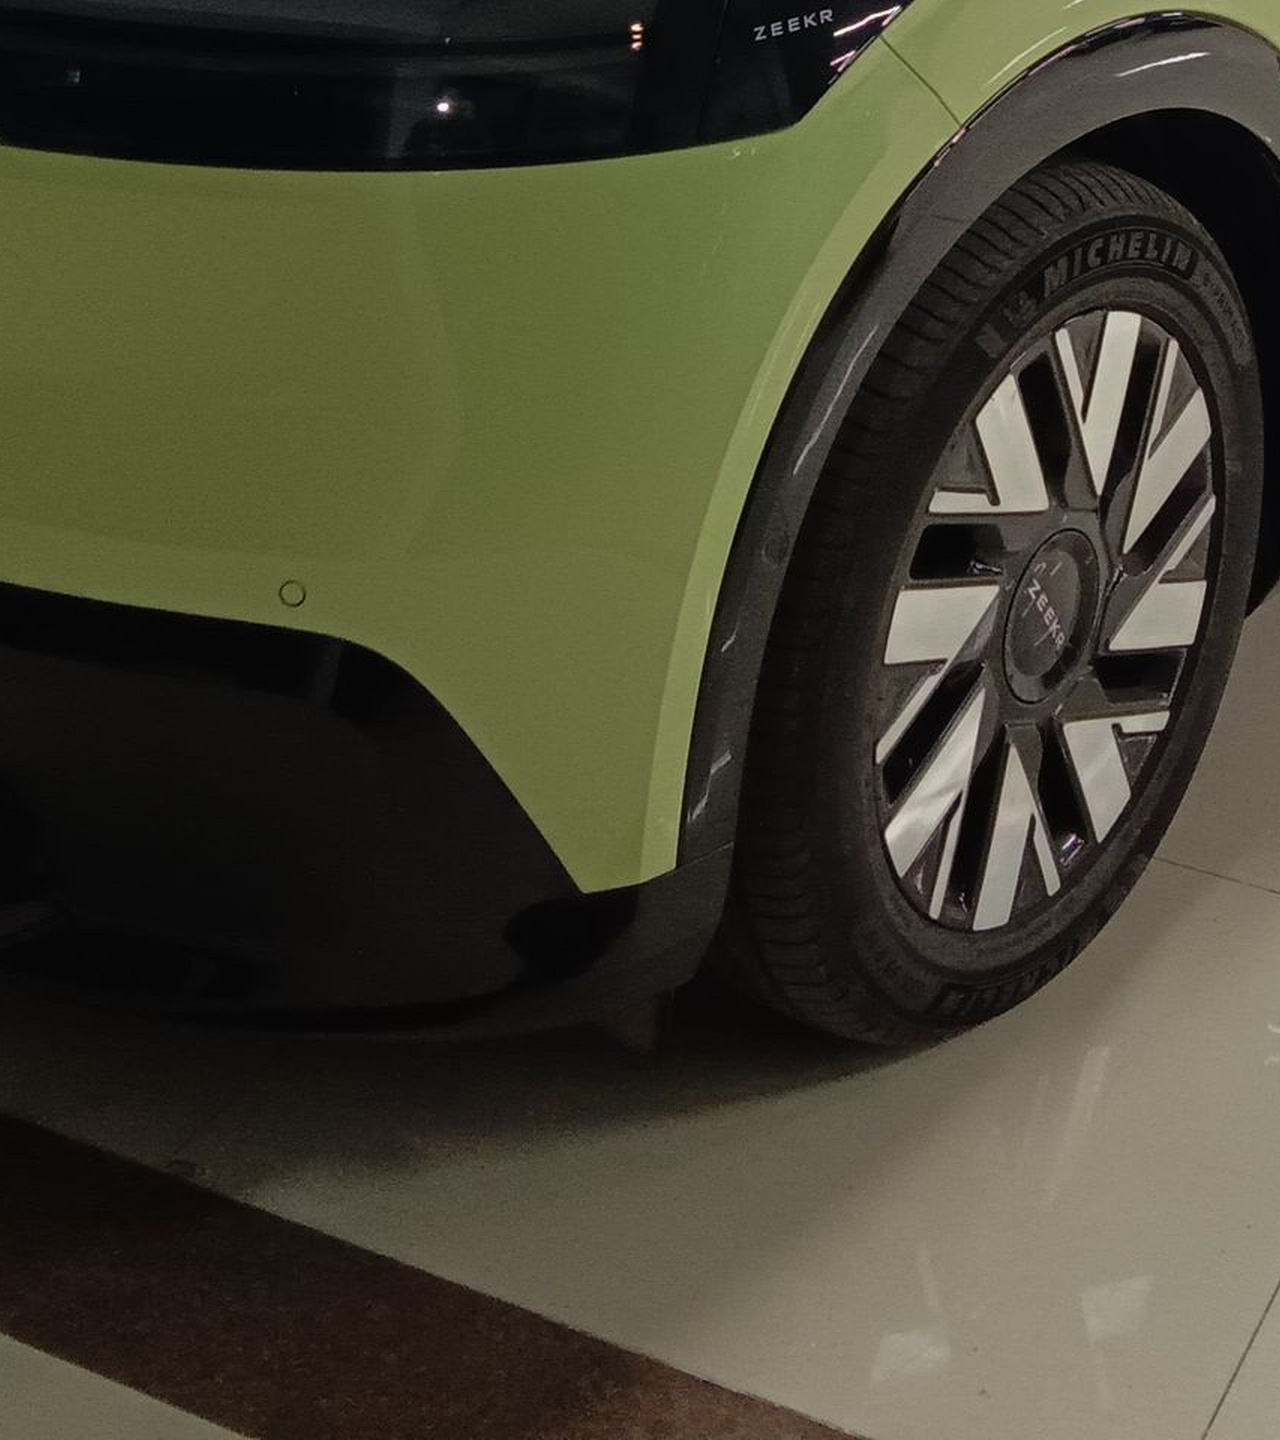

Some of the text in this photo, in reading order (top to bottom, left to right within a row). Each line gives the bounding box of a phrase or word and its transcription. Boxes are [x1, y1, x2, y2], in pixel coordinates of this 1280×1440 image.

[753, 9, 834, 42] ZEEKR
[1043, 231, 1193, 298] MICHELIN
[1024, 578, 1066, 651] ZEEKR
